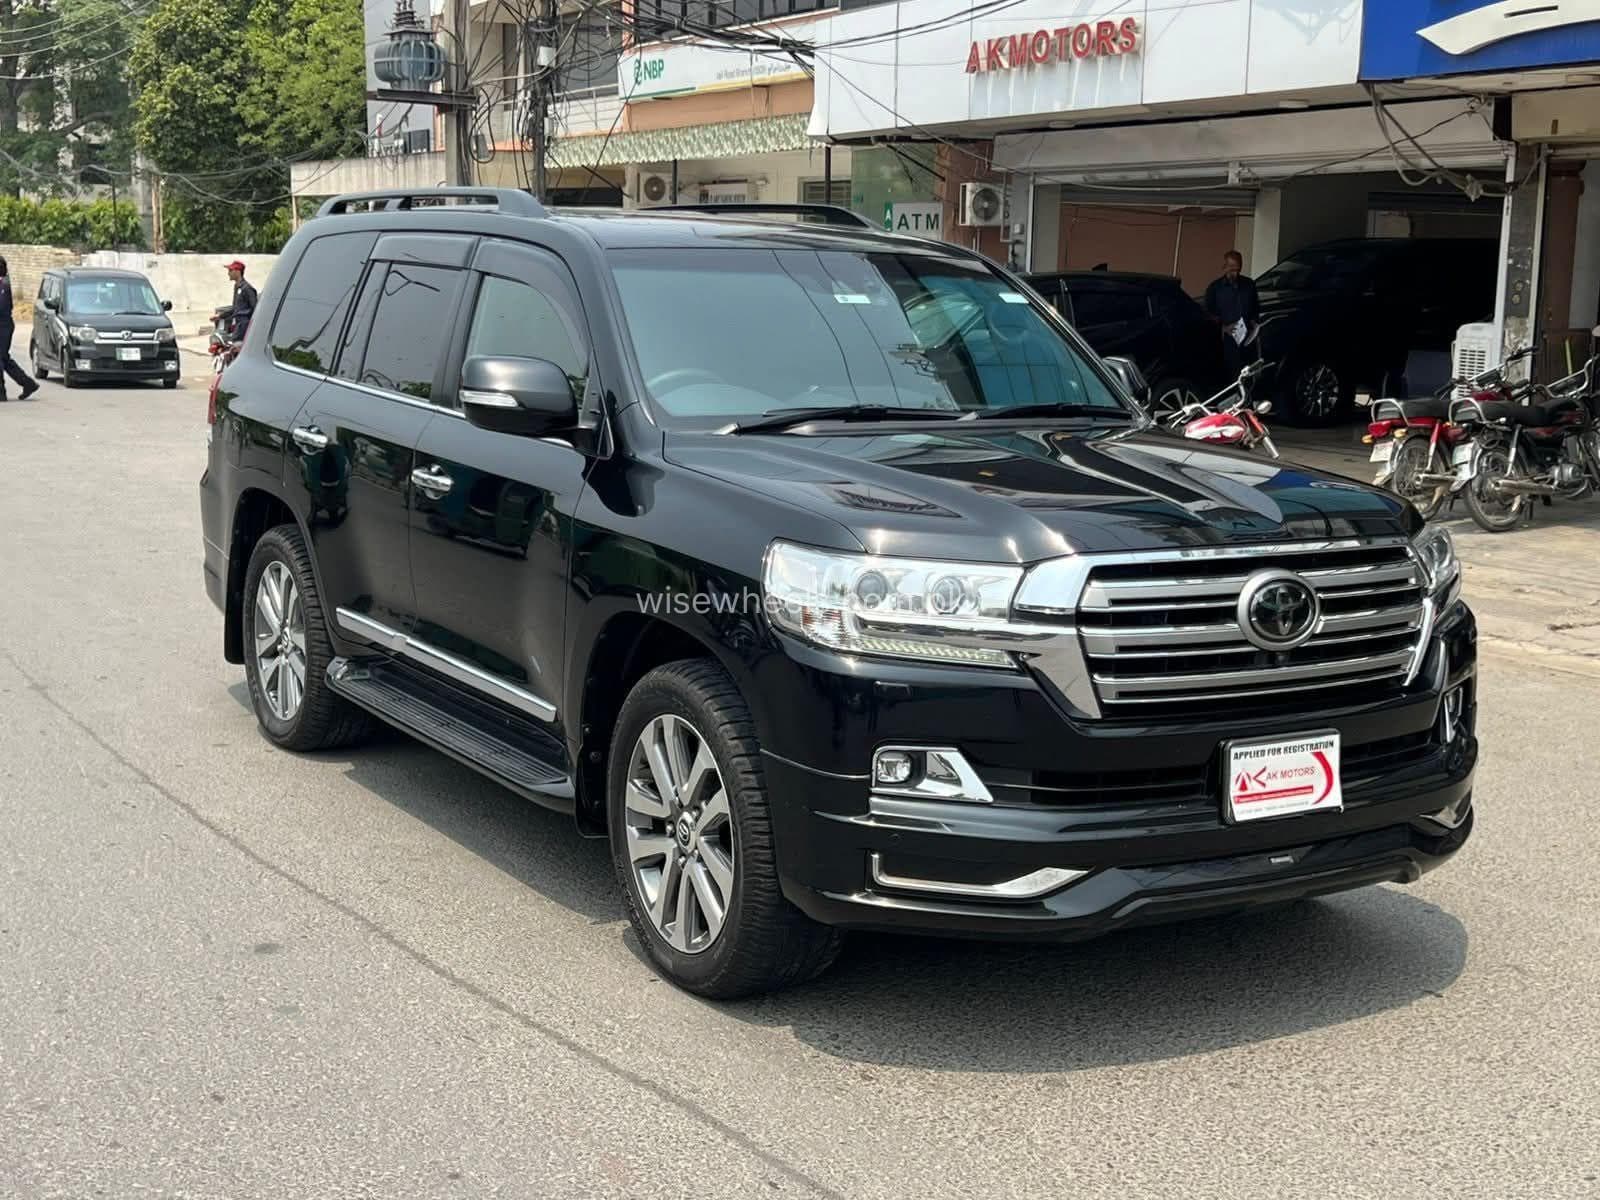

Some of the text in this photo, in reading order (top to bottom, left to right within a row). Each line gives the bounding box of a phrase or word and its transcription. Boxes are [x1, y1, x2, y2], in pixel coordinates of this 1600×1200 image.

[643, 59, 665, 80] NBP
[897, 213, 940, 230] ATM
[1233, 741, 1334, 760] APPLIED FOR REGISTRATION
[1266, 766, 1316, 780] AK MOTORS
